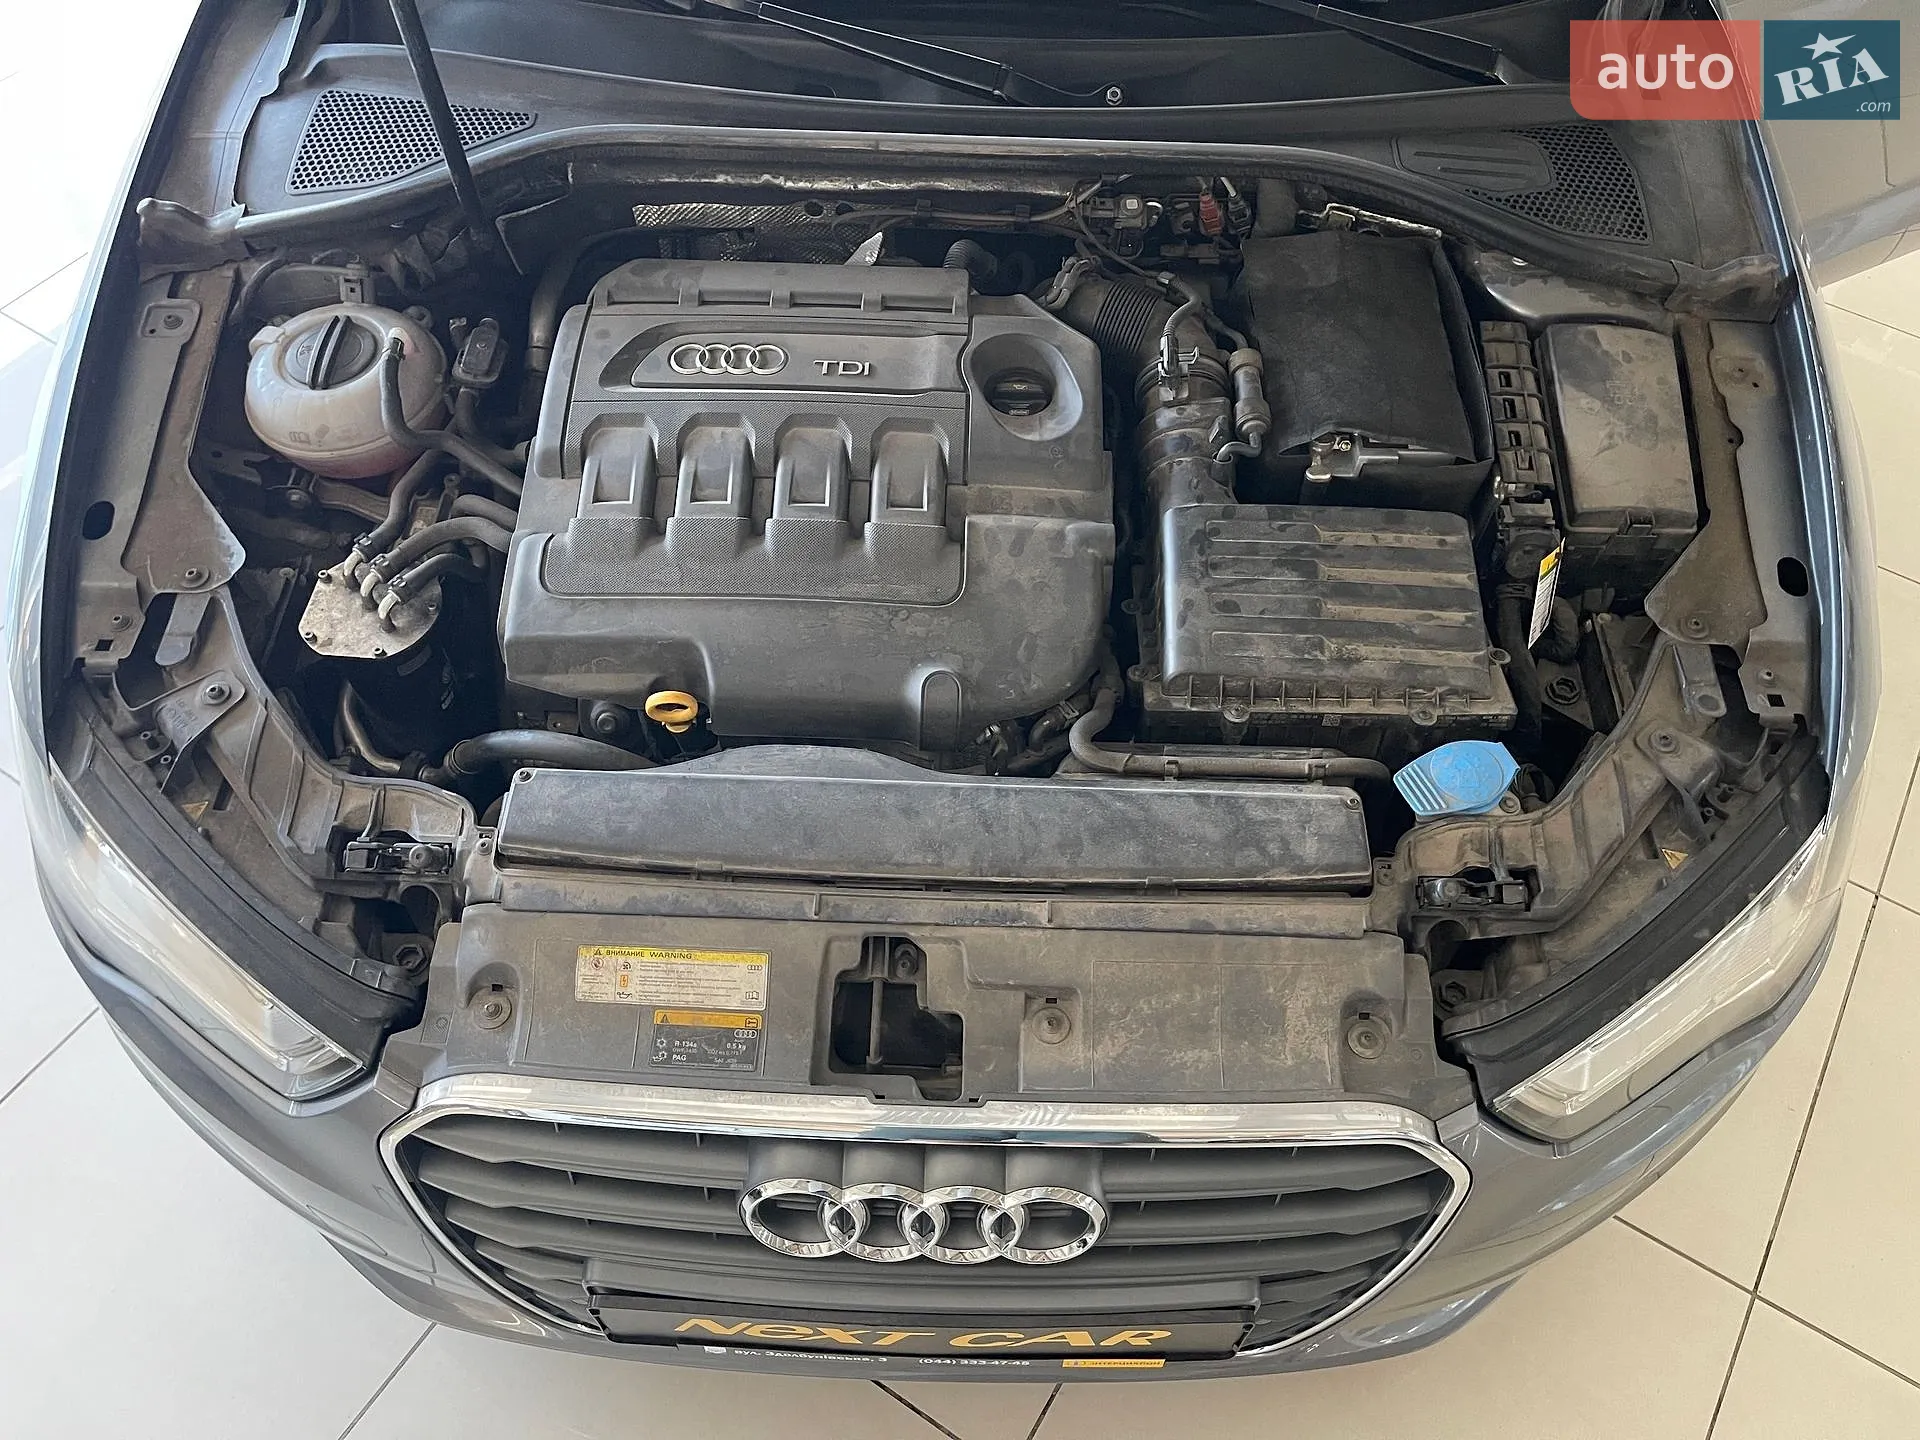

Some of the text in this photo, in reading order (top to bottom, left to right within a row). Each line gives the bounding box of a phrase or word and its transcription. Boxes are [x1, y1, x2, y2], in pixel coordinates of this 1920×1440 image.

[814, 360, 871, 377] TDI
[650, 951, 692, 960] WARNING
[949, 1330, 1172, 1347] CAR
